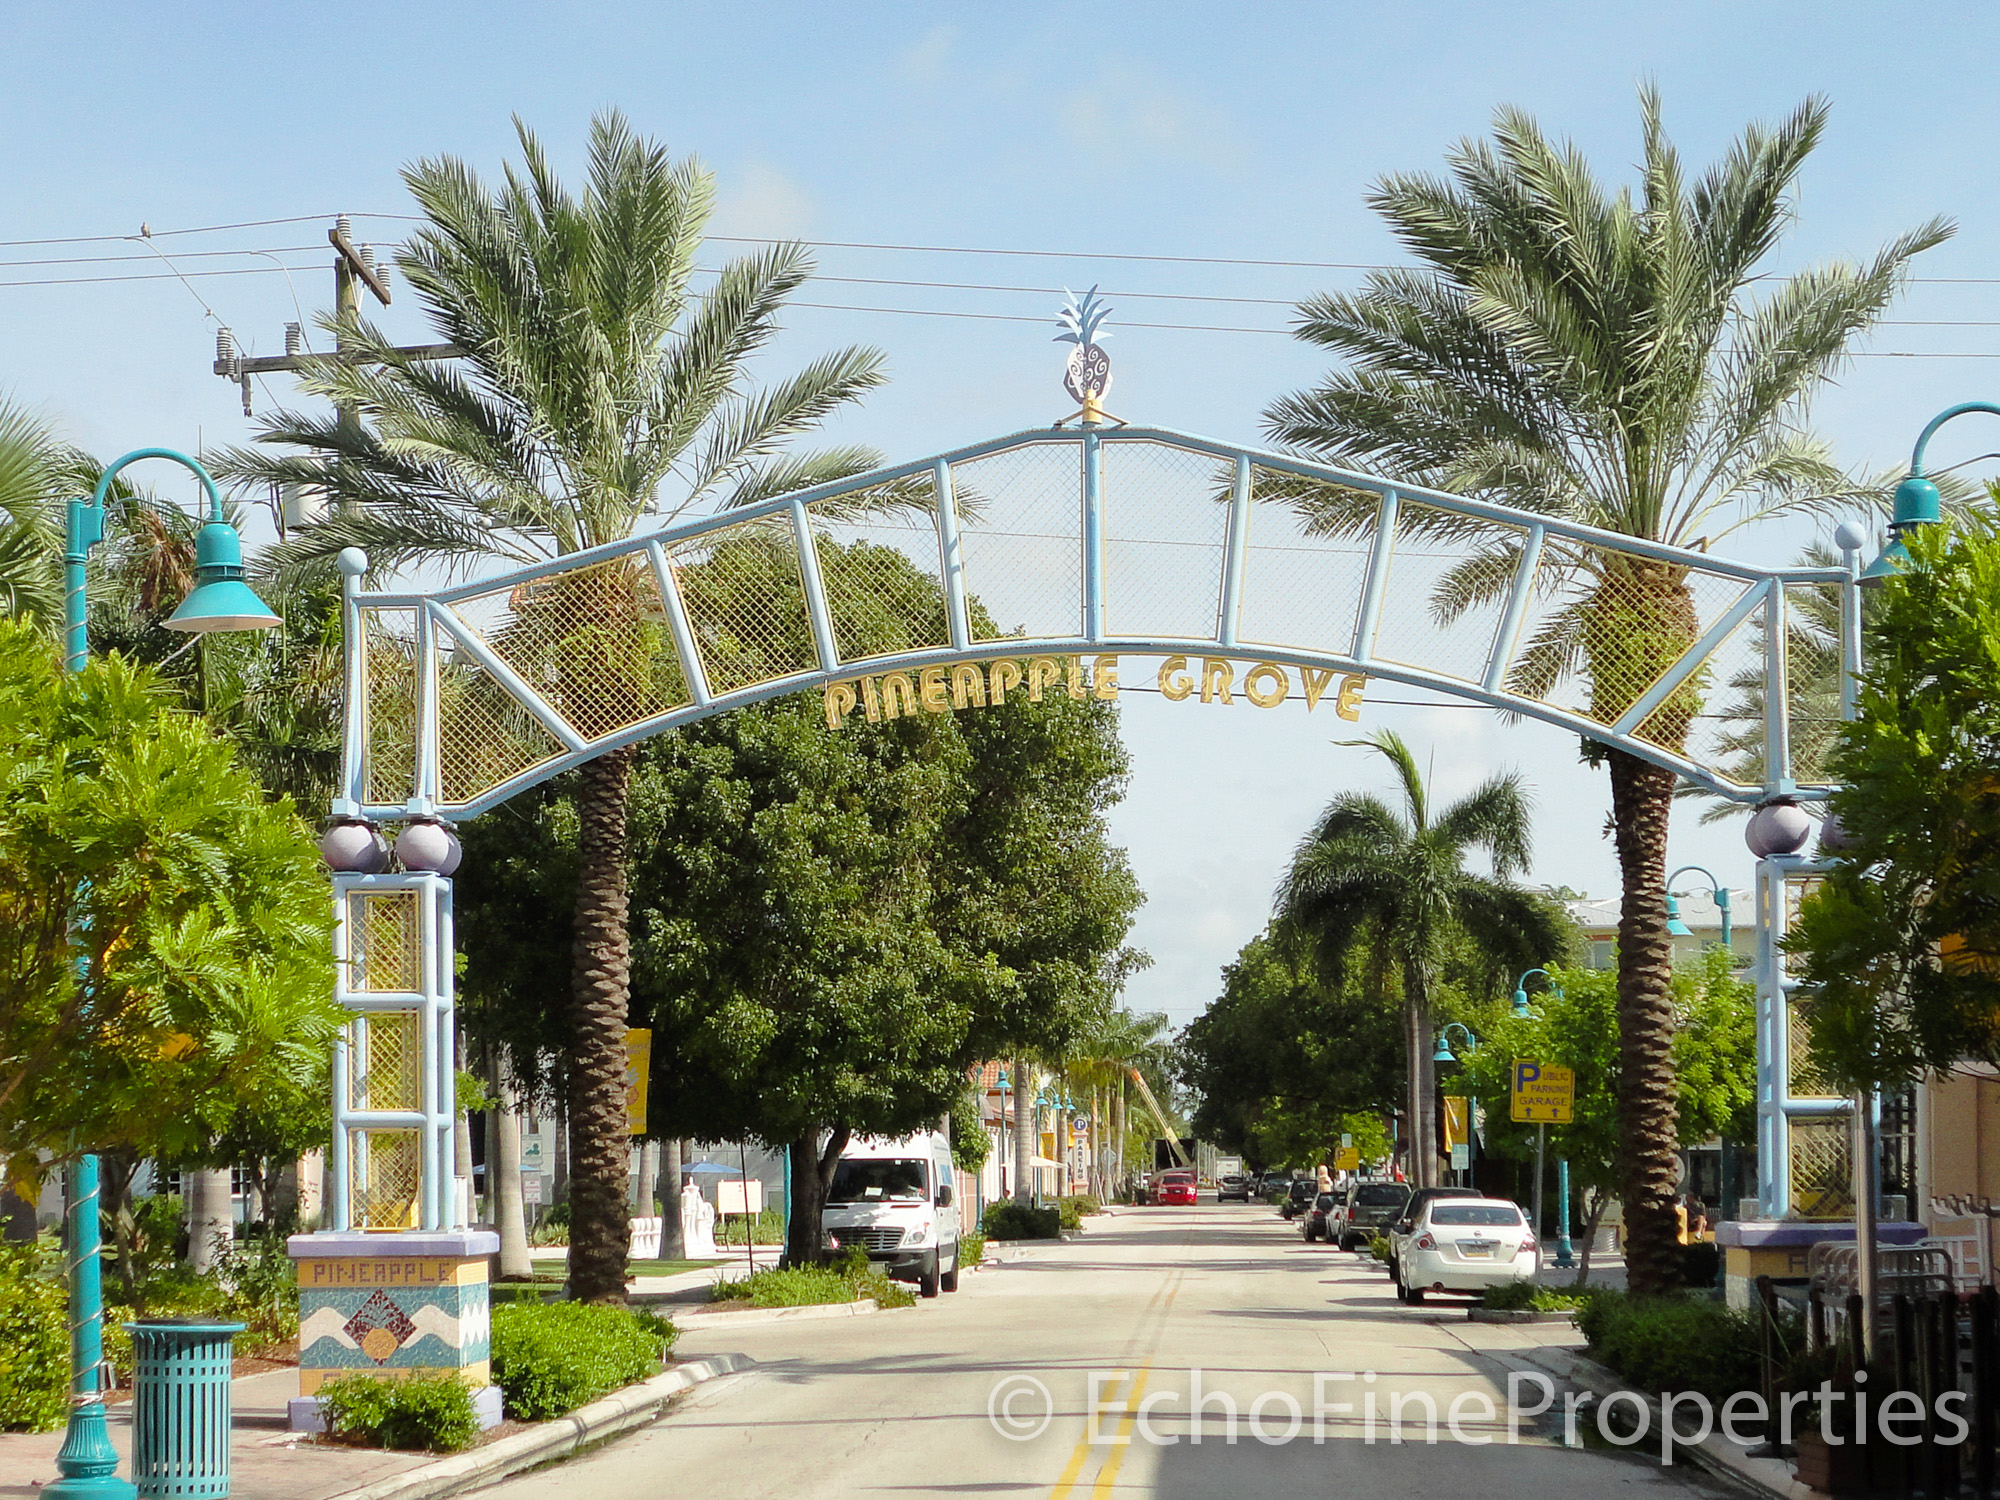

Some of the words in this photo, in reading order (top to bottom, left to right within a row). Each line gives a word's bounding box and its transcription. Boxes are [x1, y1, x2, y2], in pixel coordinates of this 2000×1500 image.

[825, 654, 1119, 730] PINEAPPLE
[1158, 655, 1367, 723] GROVE
[1531, 1085, 1569, 1094] PARKING
[1519, 1097, 1568, 1106] GARAGE
[313, 1262, 450, 1284] PINEAPPLE
